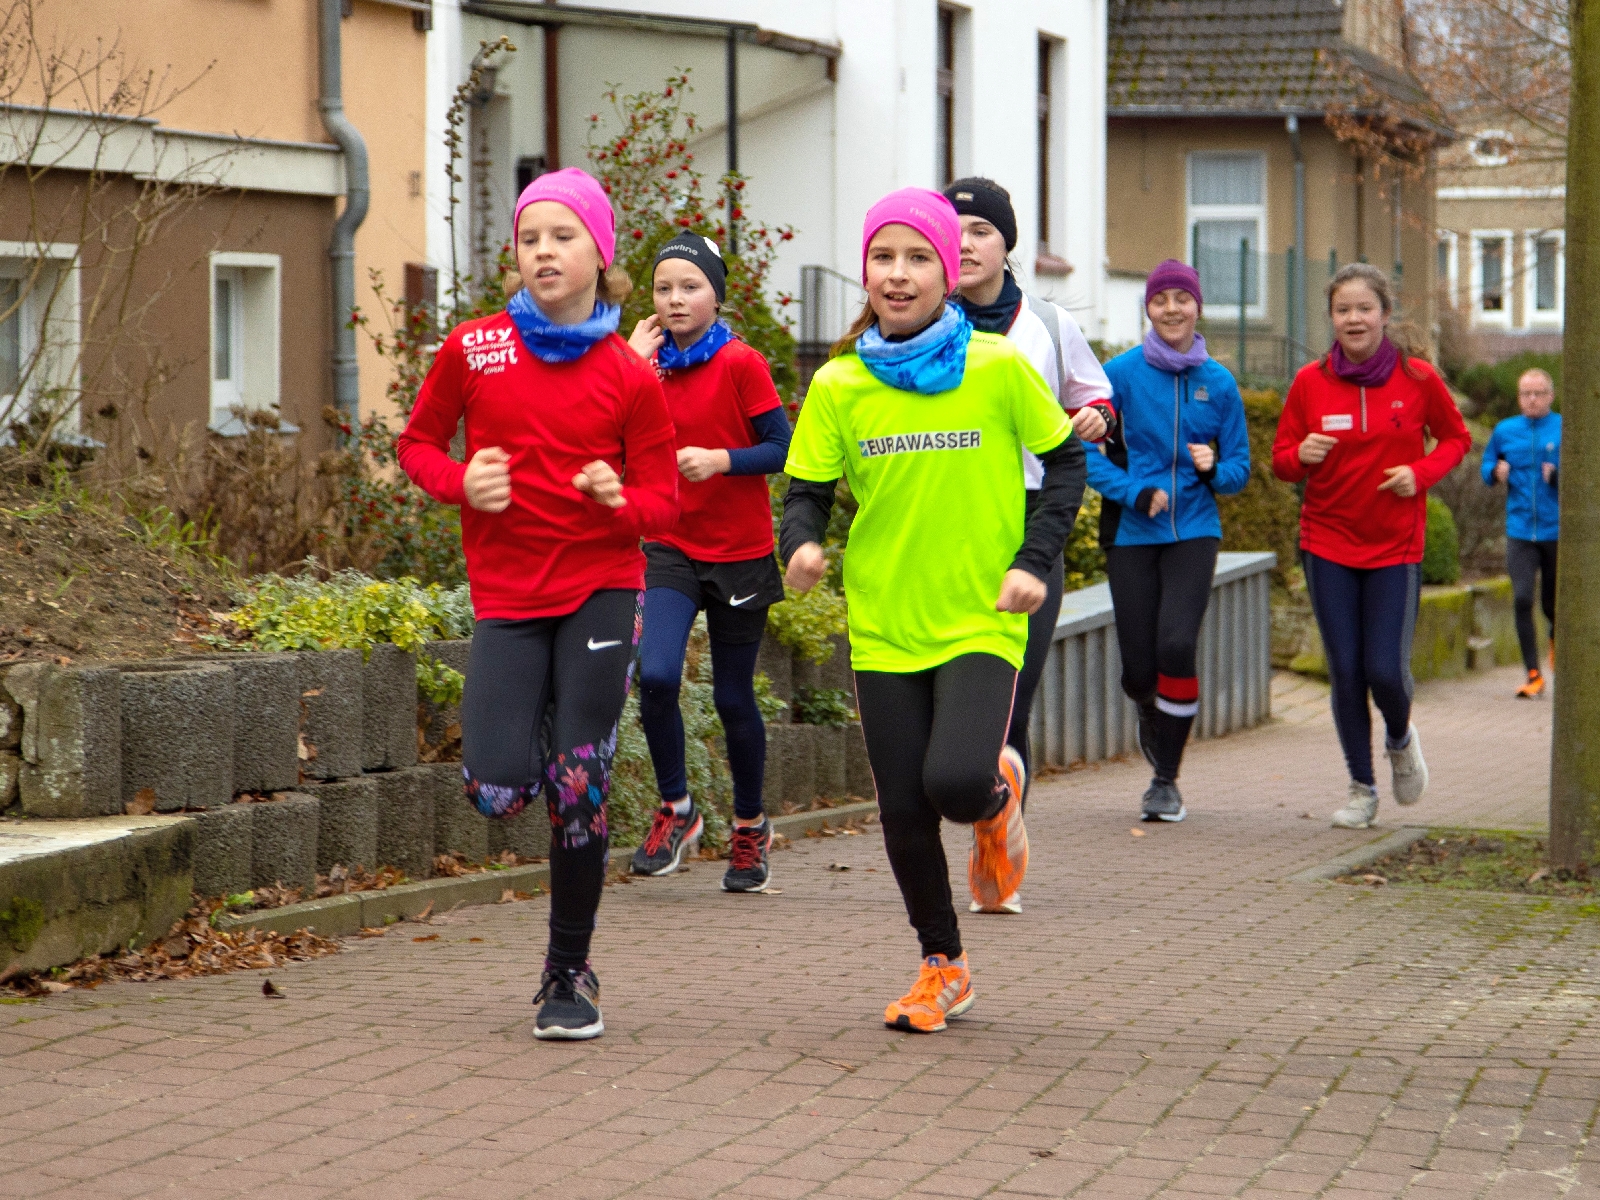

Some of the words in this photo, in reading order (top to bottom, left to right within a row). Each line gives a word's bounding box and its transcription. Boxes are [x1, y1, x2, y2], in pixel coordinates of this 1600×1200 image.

[660, 244, 698, 256] newline
[461, 327, 513, 347] city
[867, 431, 980, 456] EURAWASSER
